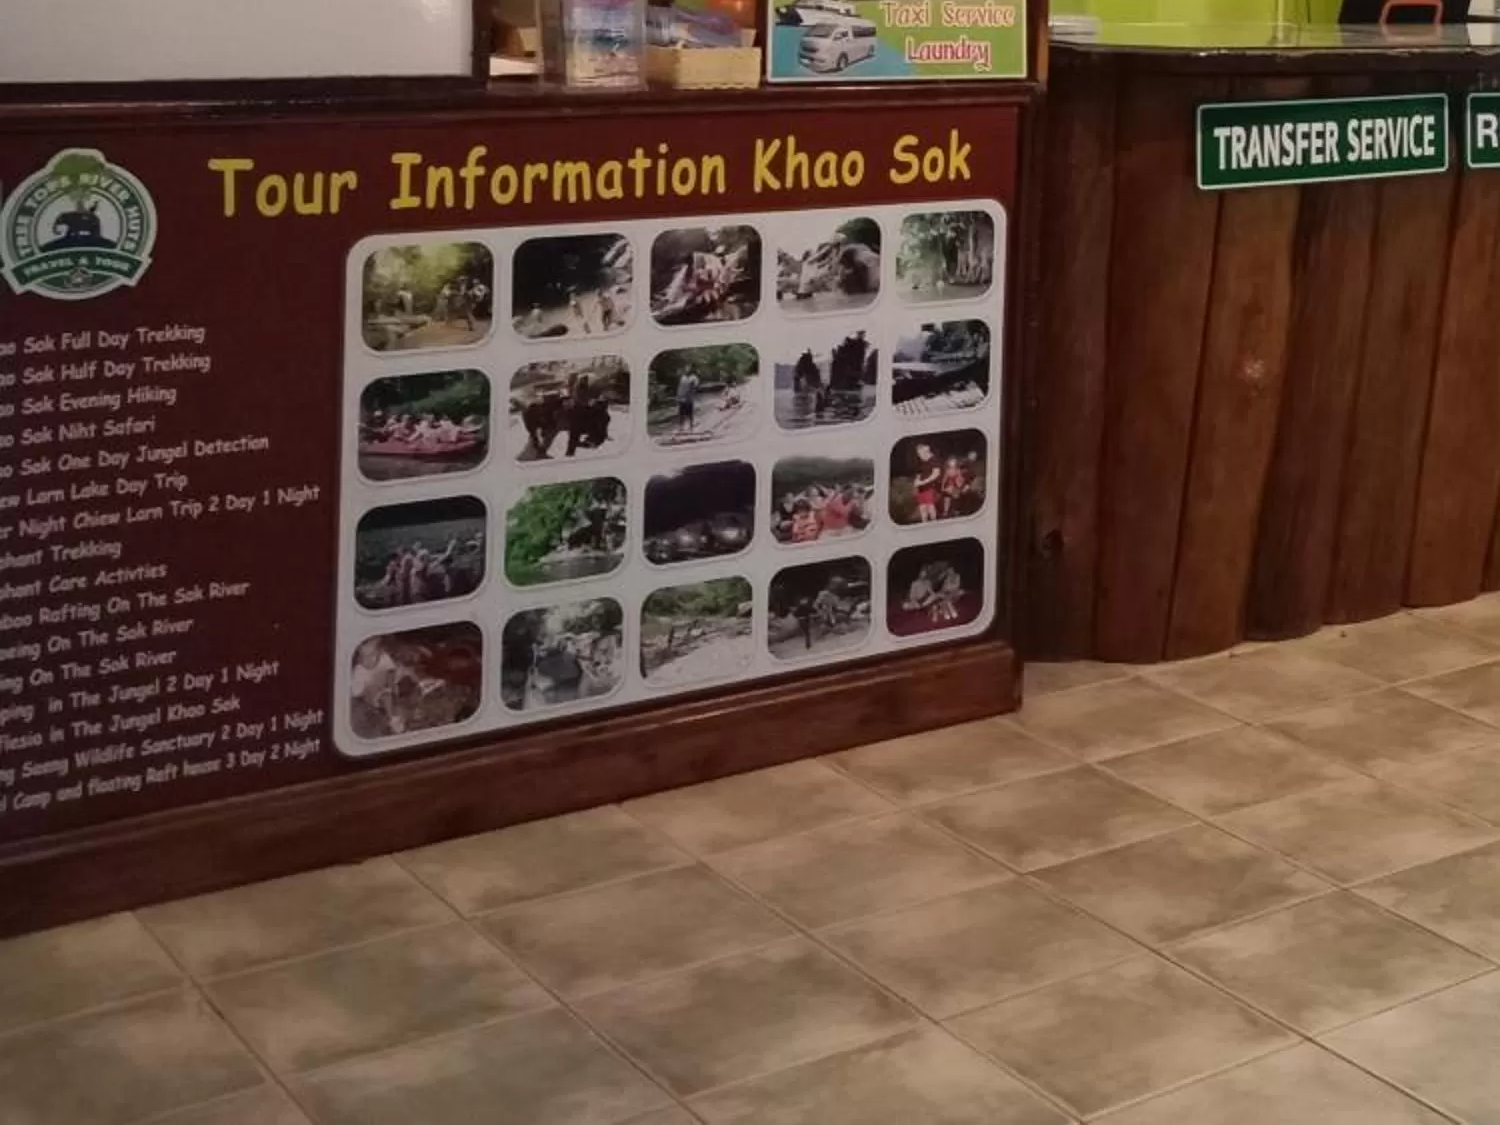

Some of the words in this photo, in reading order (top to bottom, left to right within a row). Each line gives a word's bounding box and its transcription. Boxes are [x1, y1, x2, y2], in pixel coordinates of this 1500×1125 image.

[880, 1, 929, 26] Taxi
[942, 1, 1015, 27] Service
[905, 36, 993, 71] Laundry
[1214, 121, 1340, 170] TRANSFER
[1347, 114, 1436, 162] SERVICE
[208, 157, 358, 217] Tour
[389, 142, 726, 211] Information
[752, 134, 865, 194] Khao
[888, 128, 972, 184] Sok
[24, 335, 55, 354] Sok
[61, 331, 91, 350] Full
[98, 331, 129, 349] Day
[136, 325, 206, 344] Trekking
[23, 364, 54, 384] Sok
[103, 360, 135, 379] Day
[143, 354, 212, 373] Trekking
[21, 395, 54, 415] Sok
[127, 386, 177, 405] Hiking
[104, 415, 156, 436] Safari
[58, 454, 92, 471] One
[98, 450, 130, 469] Day
[194, 435, 270, 456] Detection
[116, 478, 148, 496] Day
[154, 472, 189, 491] Trip
[19, 516, 66, 539] Night
[169, 499, 202, 519] Trip
[208, 495, 220, 512] 2
[226, 493, 256, 512] Day
[277, 484, 320, 506] Night
[50, 540, 122, 561] Trekking
[39, 603, 100, 624] Rafting
[107, 596, 131, 613] On
[137, 592, 167, 609] The
[174, 586, 203, 604] Sok
[209, 582, 250, 599] River
[48, 635, 72, 653] On
[77, 629, 109, 648] The
[116, 622, 147, 643] Sok
[152, 619, 195, 635] River
[30, 669, 54, 686] On
[61, 663, 92, 680] The
[100, 655, 129, 675] Sok
[135, 651, 177, 667] River
[69, 692, 100, 709] The
[167, 676, 177, 691] 2
[183, 673, 215, 691] Day
[236, 661, 280, 682] Night
[72, 721, 103, 738] The
[211, 694, 241, 714] Sok
[221, 725, 230, 740] 2
[236, 721, 265, 740] Day
[284, 710, 324, 731] Night
[240, 749, 266, 767] Day
[270, 744, 280, 760] 2
[284, 739, 321, 759] Night
